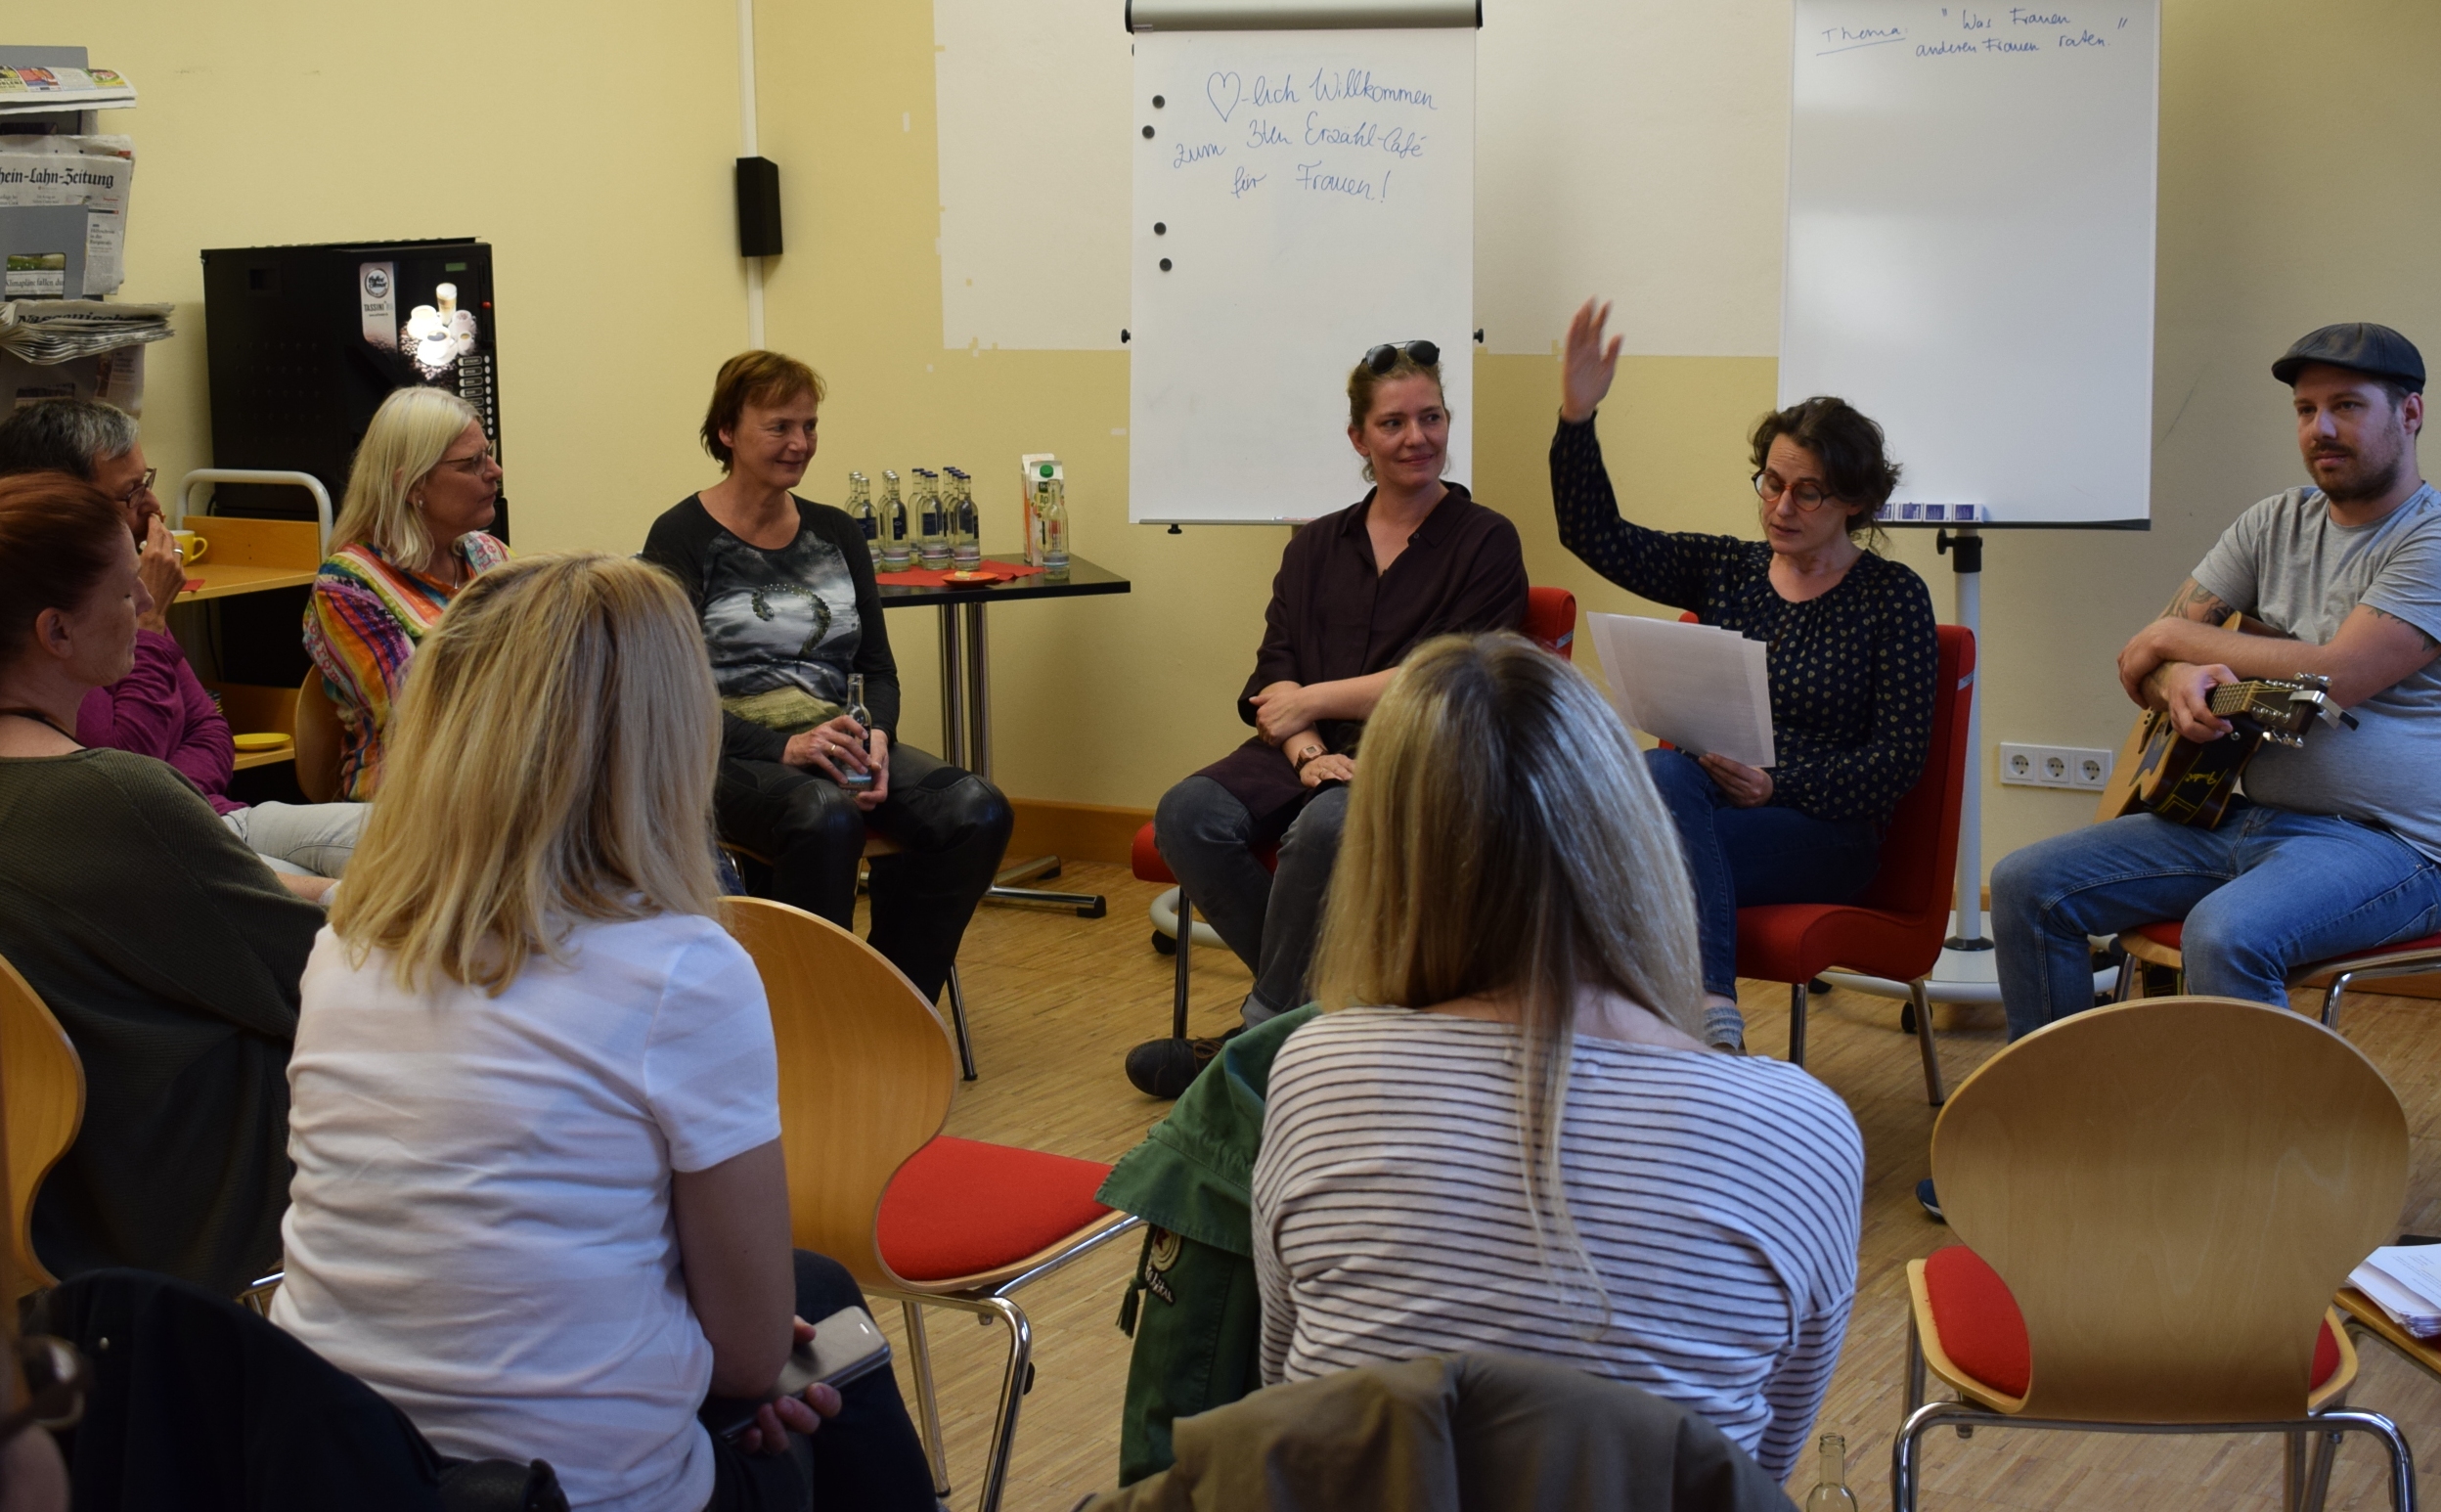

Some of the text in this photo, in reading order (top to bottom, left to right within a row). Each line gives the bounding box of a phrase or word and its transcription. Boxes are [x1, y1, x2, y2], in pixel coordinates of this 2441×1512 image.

[2010, 7, 2070, 25] Frauen
[1915, 40, 1976, 57] anderen
[1982, 37, 2040, 53] Frauen
[1309, 67, 1438, 111] Willkommen
